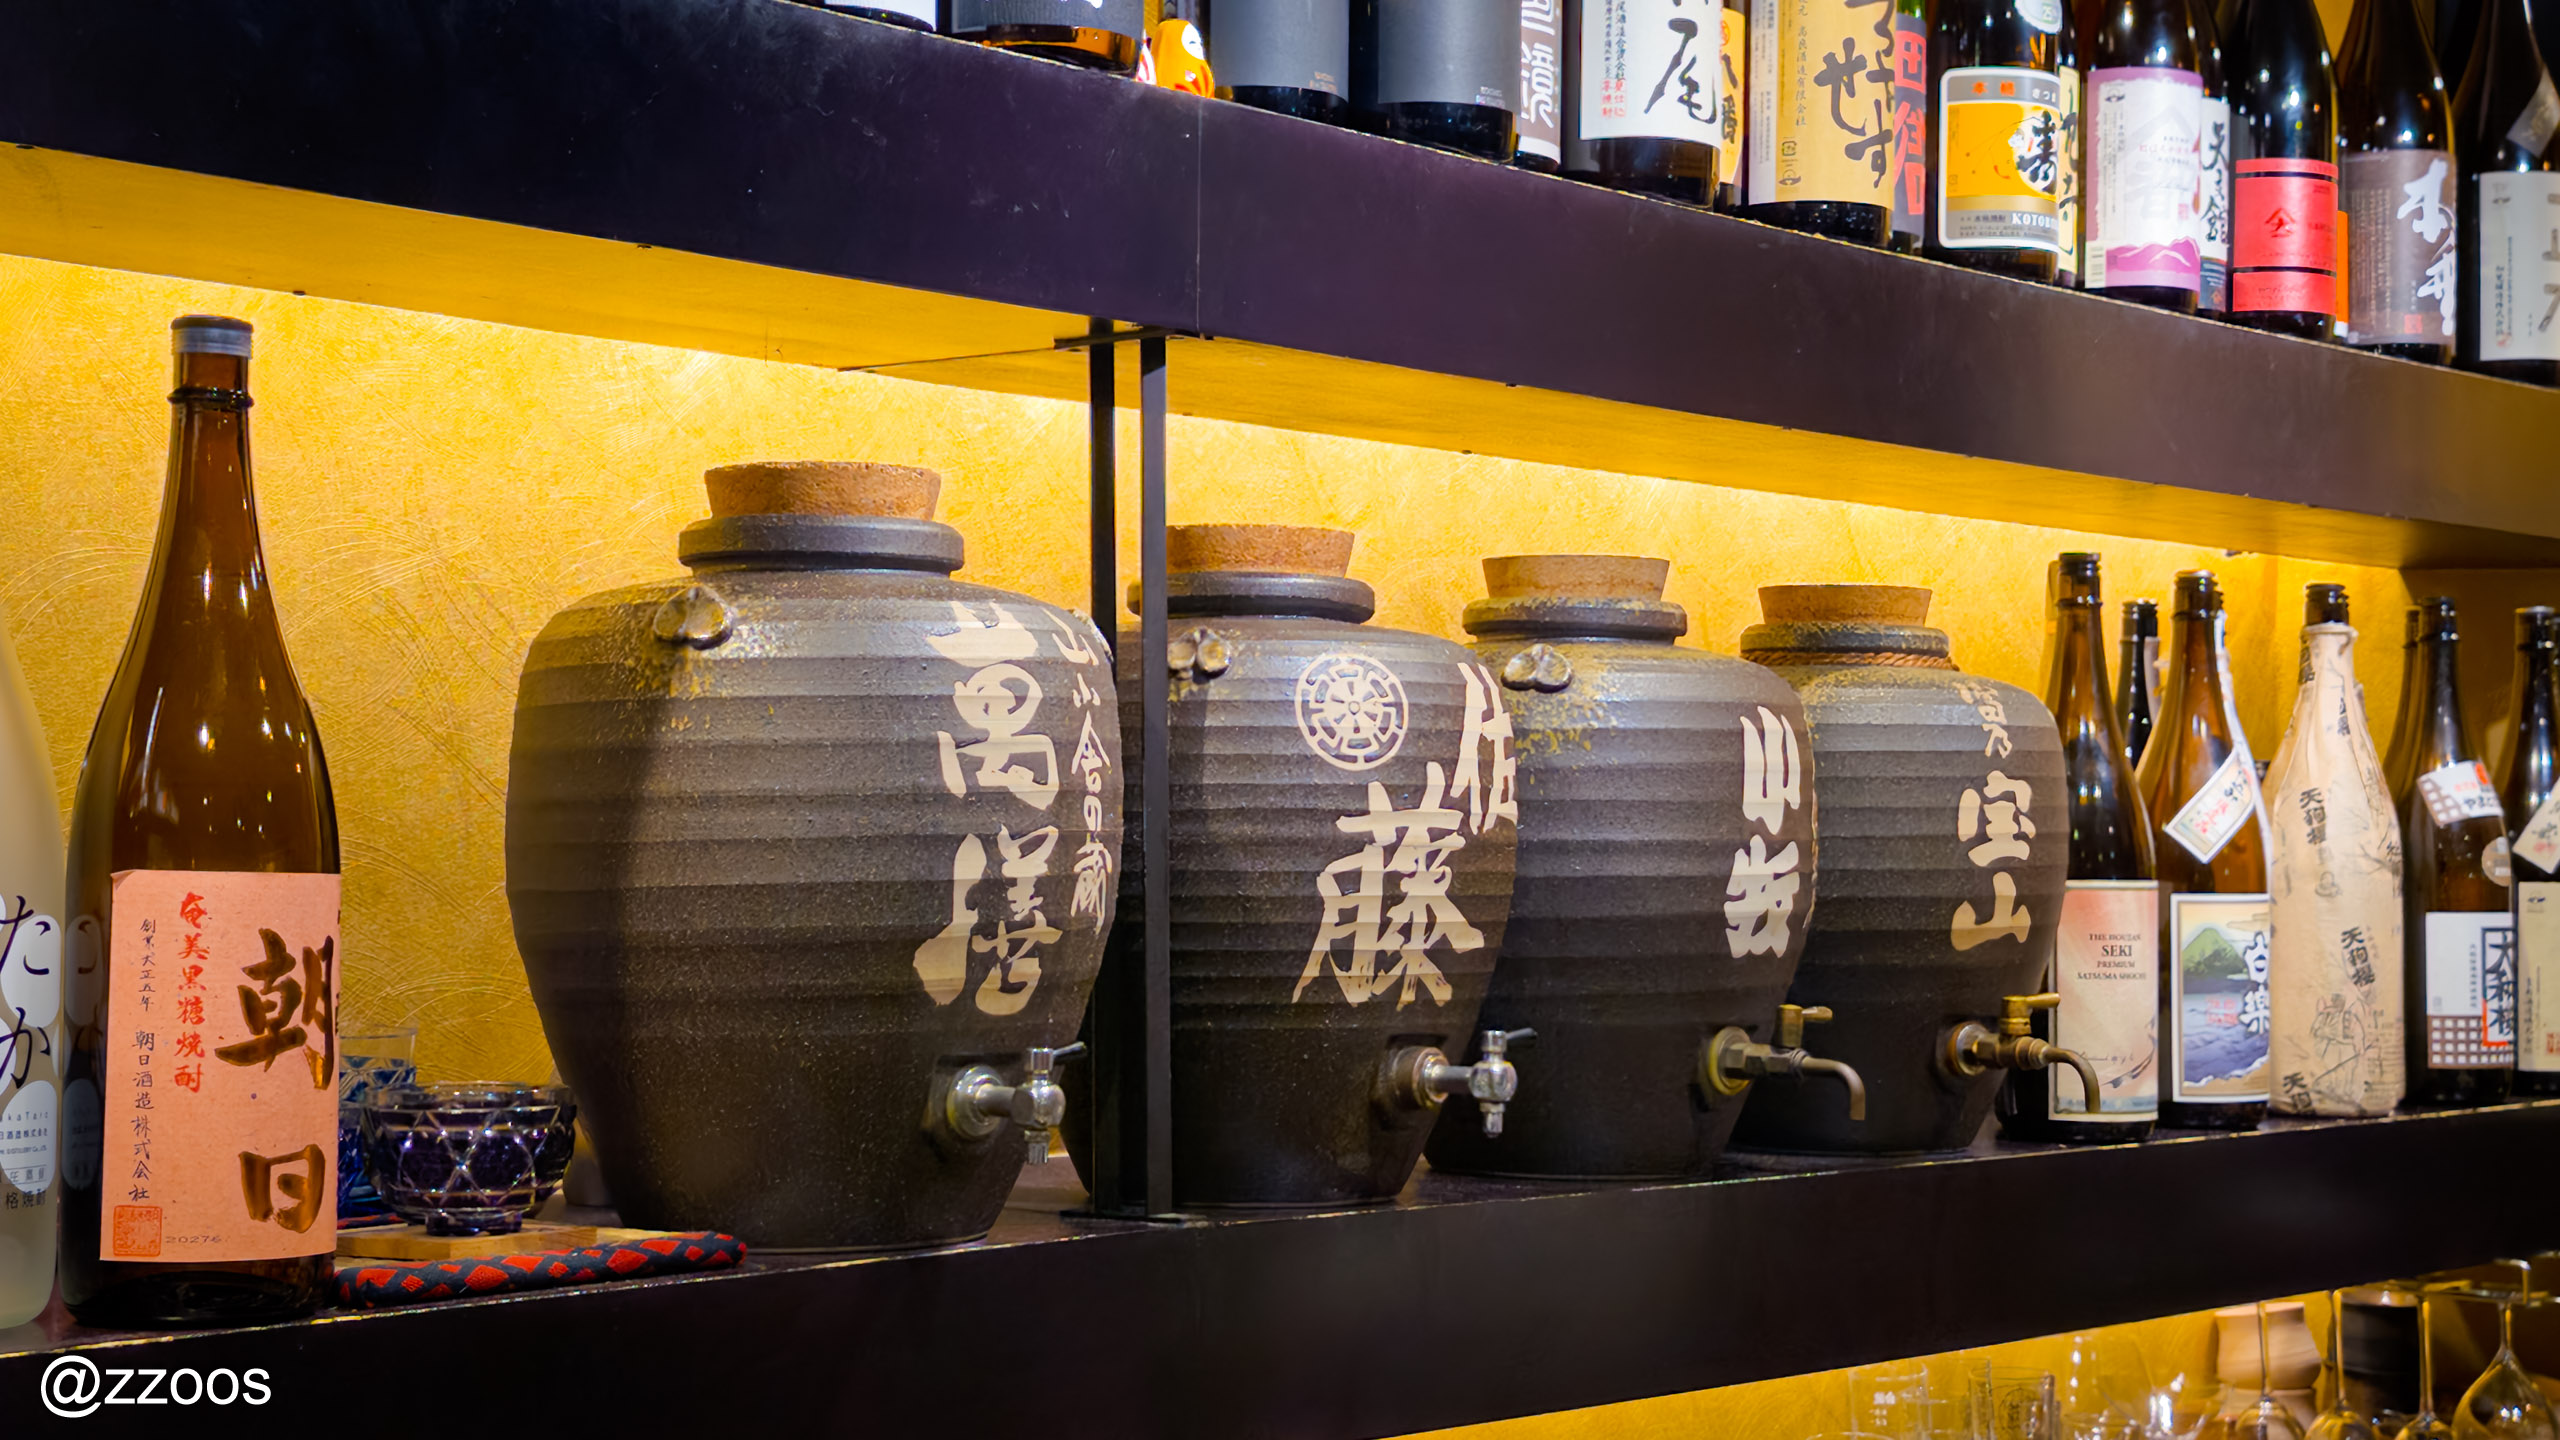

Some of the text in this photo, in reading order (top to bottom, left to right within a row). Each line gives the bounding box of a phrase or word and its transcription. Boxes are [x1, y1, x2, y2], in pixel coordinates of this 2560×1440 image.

[1644, 0, 1716, 124] 尾
[2089, 933, 2107, 941] THE
[2097, 961, 2135, 969] PREMIUM
[2101, 945, 2133, 957] SEKI
[174, 891, 210, 1094] 奄美黒糖焼酎
[2077, 972, 2117, 980] SATSUMA
[215, 928, 335, 1234] 朝日
[128, 1031, 156, 1201] 朝日酒造株式会社
